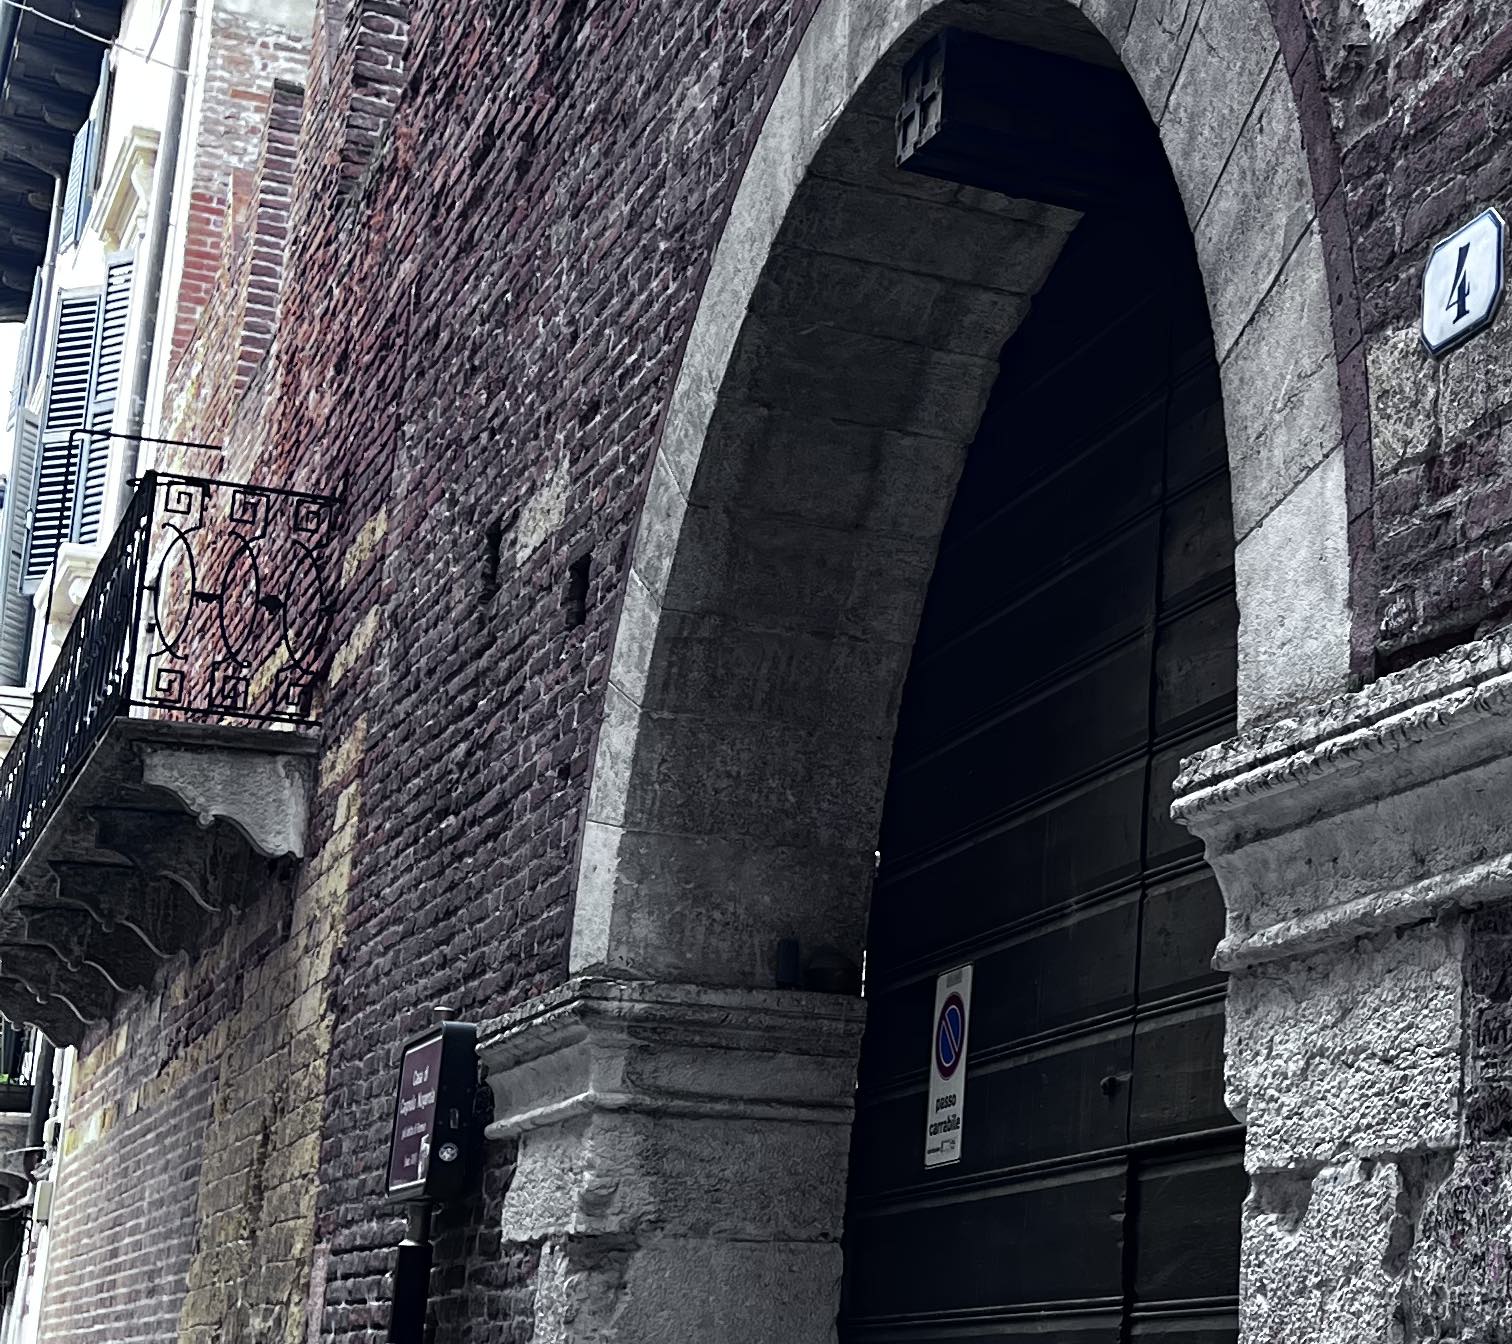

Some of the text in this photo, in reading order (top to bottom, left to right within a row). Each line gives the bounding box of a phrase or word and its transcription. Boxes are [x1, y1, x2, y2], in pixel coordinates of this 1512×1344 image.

[1446, 242, 1471, 324] 4
[935, 1094, 957, 1113] passo
[928, 1114, 961, 1137] carrabile
